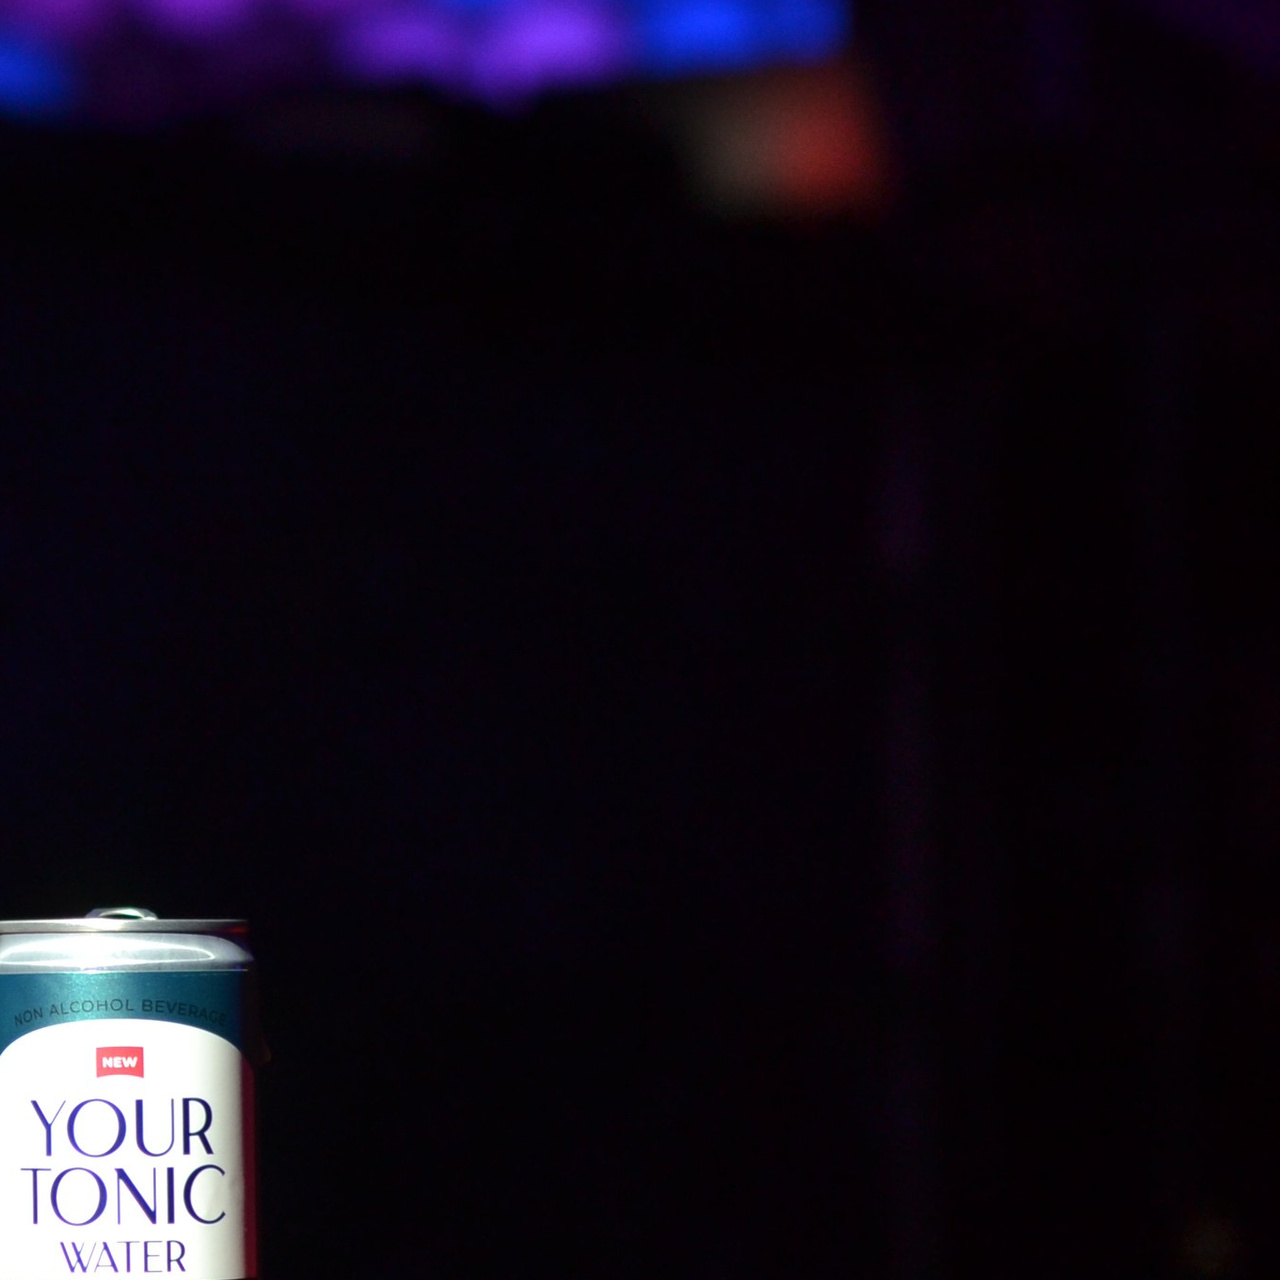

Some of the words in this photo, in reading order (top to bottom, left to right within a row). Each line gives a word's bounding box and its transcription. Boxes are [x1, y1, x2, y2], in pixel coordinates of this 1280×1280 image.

[13, 1006, 43, 1027] NON
[50, 998, 134, 1018] ALCOHOL
[142, 999, 227, 1026] BEVERAGE
[102, 1056, 138, 1068] NEW
[30, 1097, 214, 1158] YOUR
[20, 1164, 226, 1226] TONIC
[60, 1240, 186, 1273] WATER
